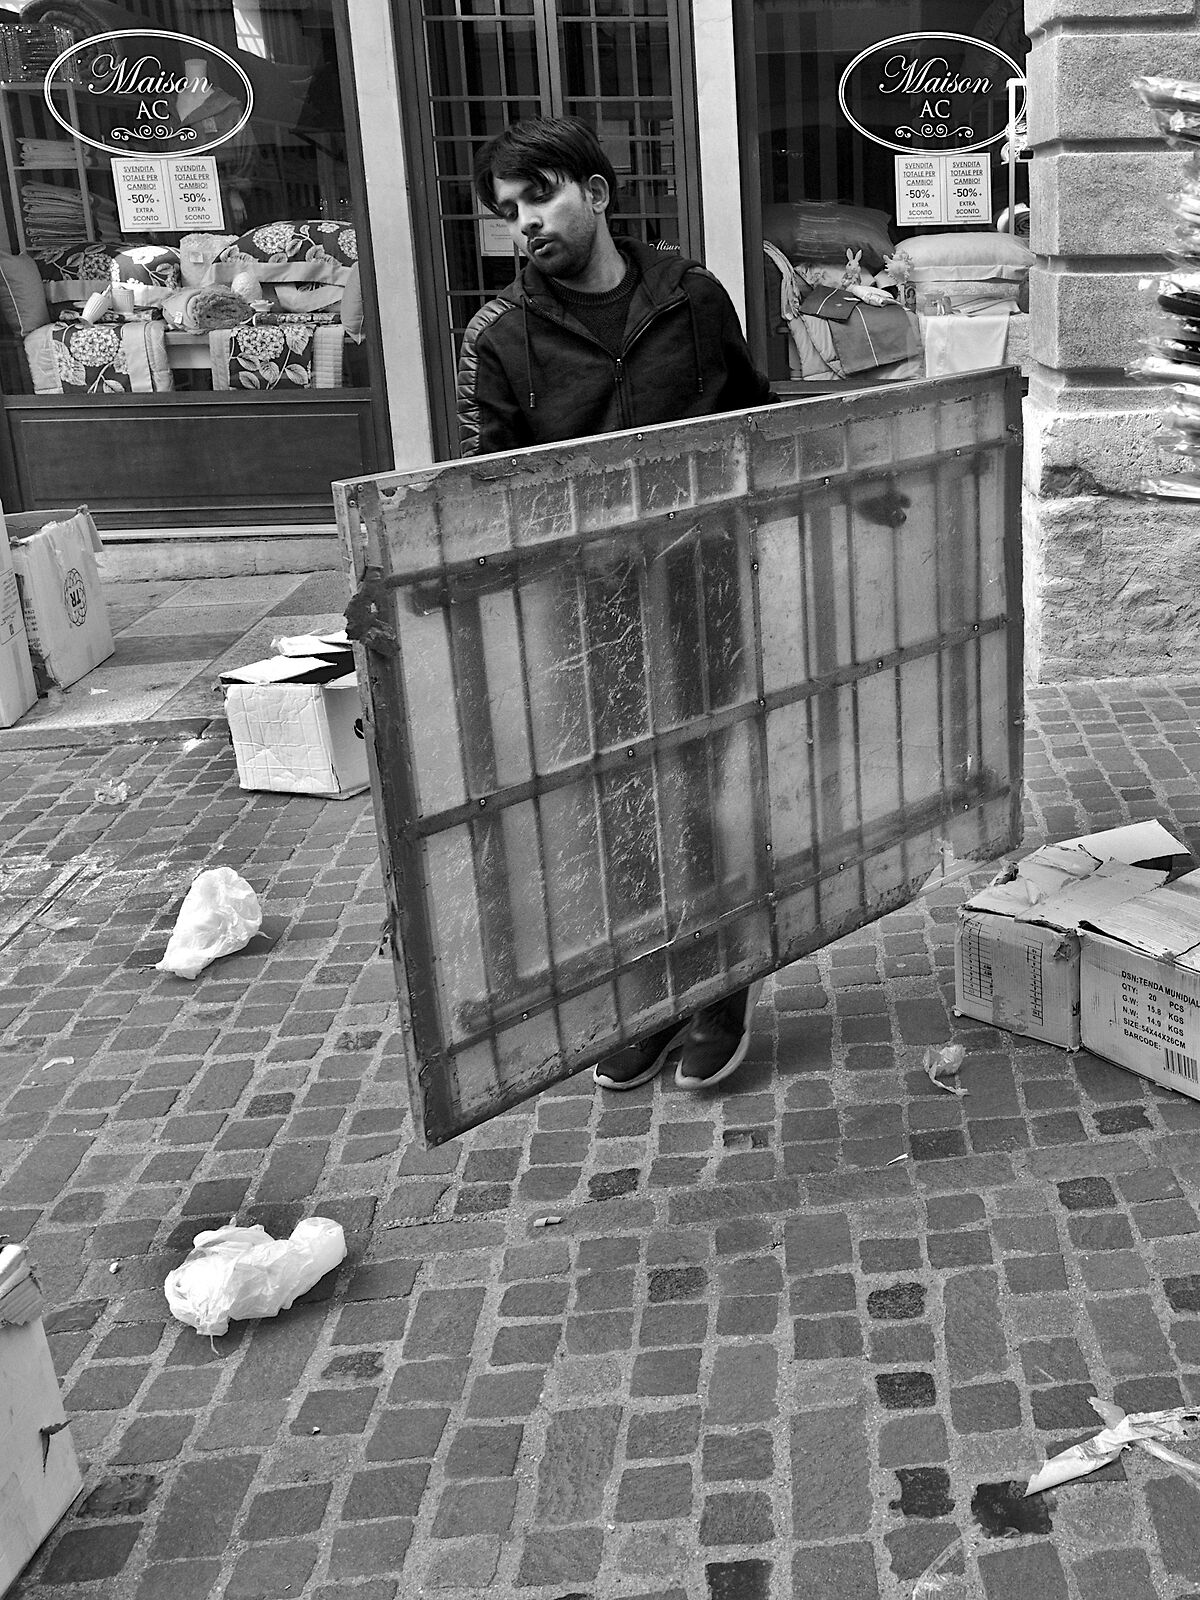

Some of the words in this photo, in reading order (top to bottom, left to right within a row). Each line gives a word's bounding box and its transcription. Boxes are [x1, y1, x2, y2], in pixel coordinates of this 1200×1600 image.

[88, 54, 213, 94] Maison
[878, 55, 993, 94] Maison
[136, 100, 170, 120] AC
[919, 100, 950, 118] AC
[128, 194, 154, 203] -50%
[179, 193, 206, 203] -50%
[906, 189, 930, 198] -50%
[953, 188, 977, 197] -50%
[1121, 983, 1138, 994] QTY:
[1149, 993, 1157, 1002] 20
[1169, 1001, 1184, 1013] PCS
[1165, 987, 1200, 1008] MUNIDIAL
[1122, 994, 1139, 1006] G.W:
[1147, 1005, 1162, 1016] 15.8
[1168, 1013, 1184, 1024] KGS
[1122, 1006, 1139, 1018] N.W:
[1147, 1017, 1161, 1027] 14.9
[1168, 1025, 1184, 1036] KGS
[1124, 1029, 1161, 1050] BARCODE:
